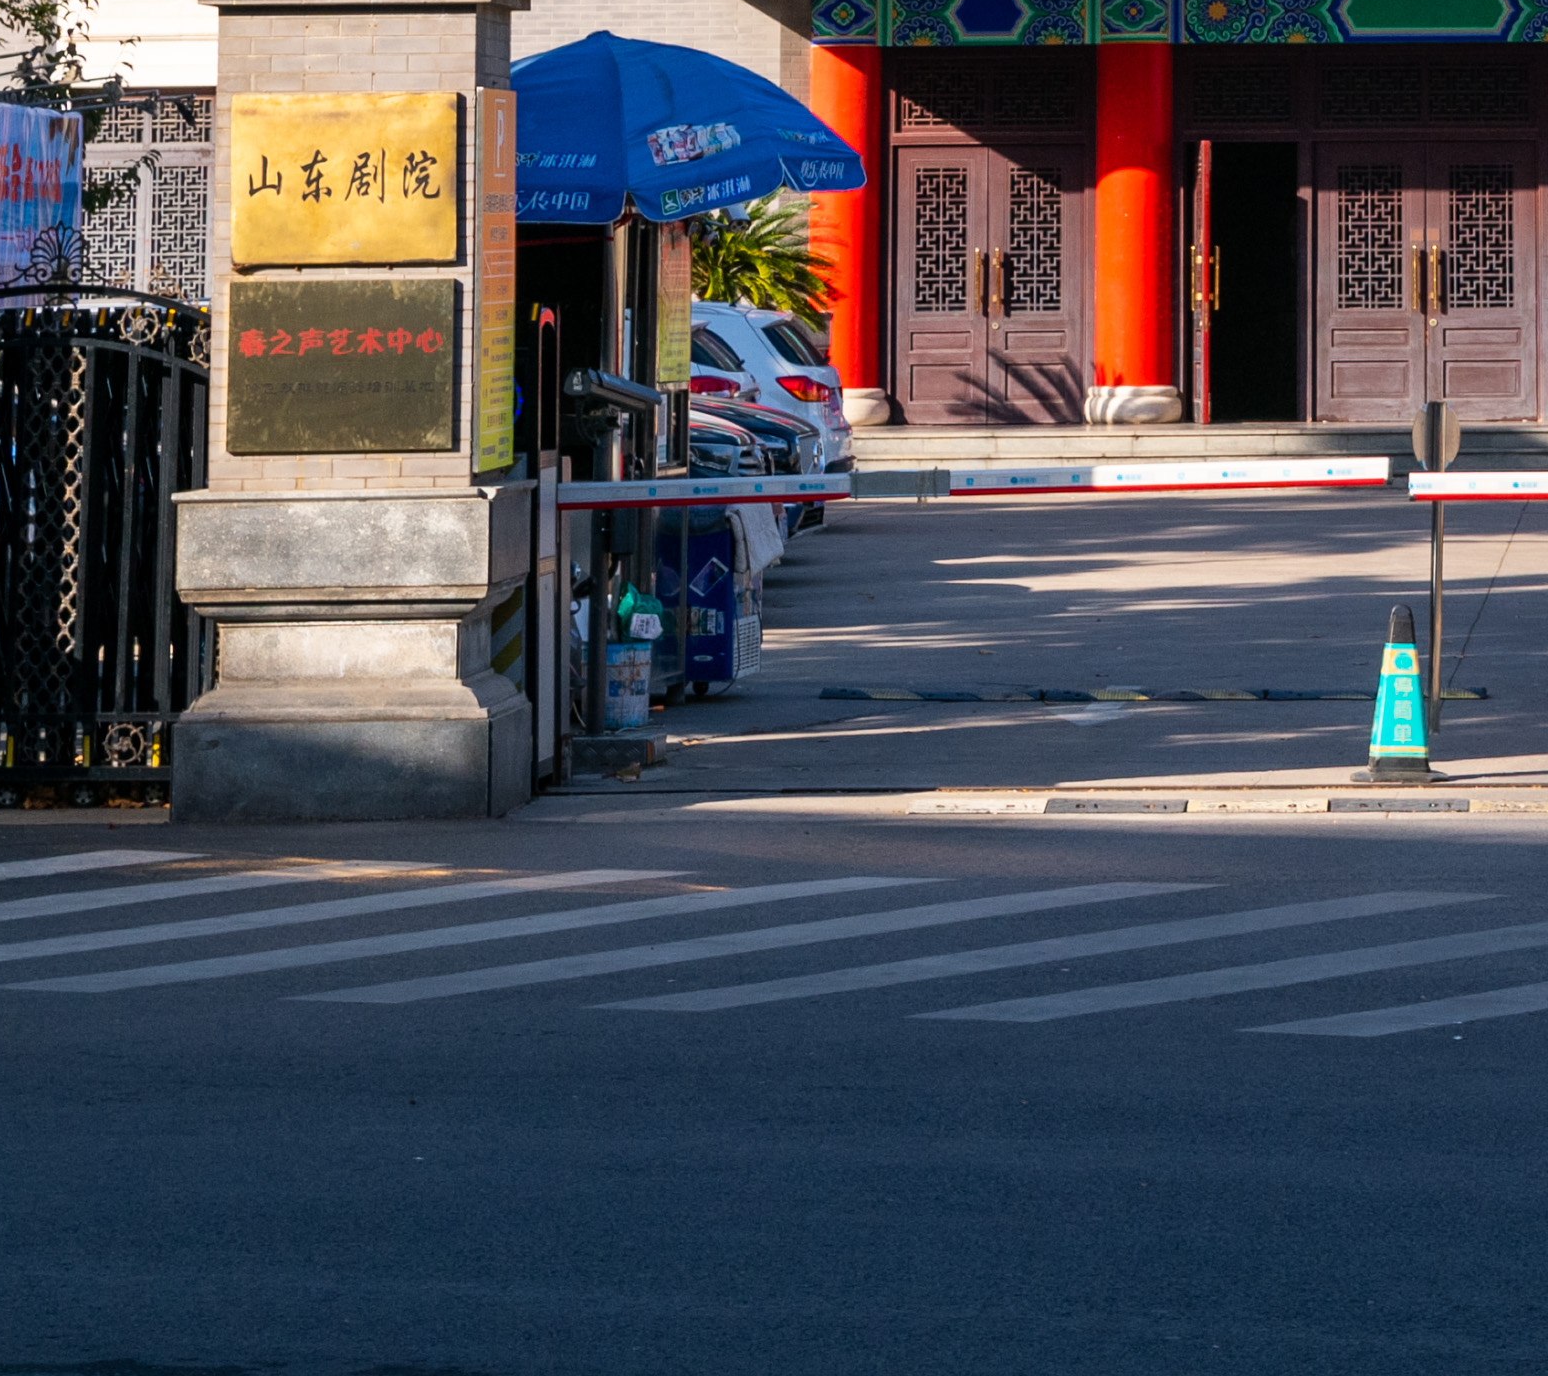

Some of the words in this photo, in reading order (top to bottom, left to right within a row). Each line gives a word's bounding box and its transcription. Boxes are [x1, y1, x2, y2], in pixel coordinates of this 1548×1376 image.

[248, 147, 441, 204] 山东剧院
[239, 327, 444, 358] 春之声艺术中心
